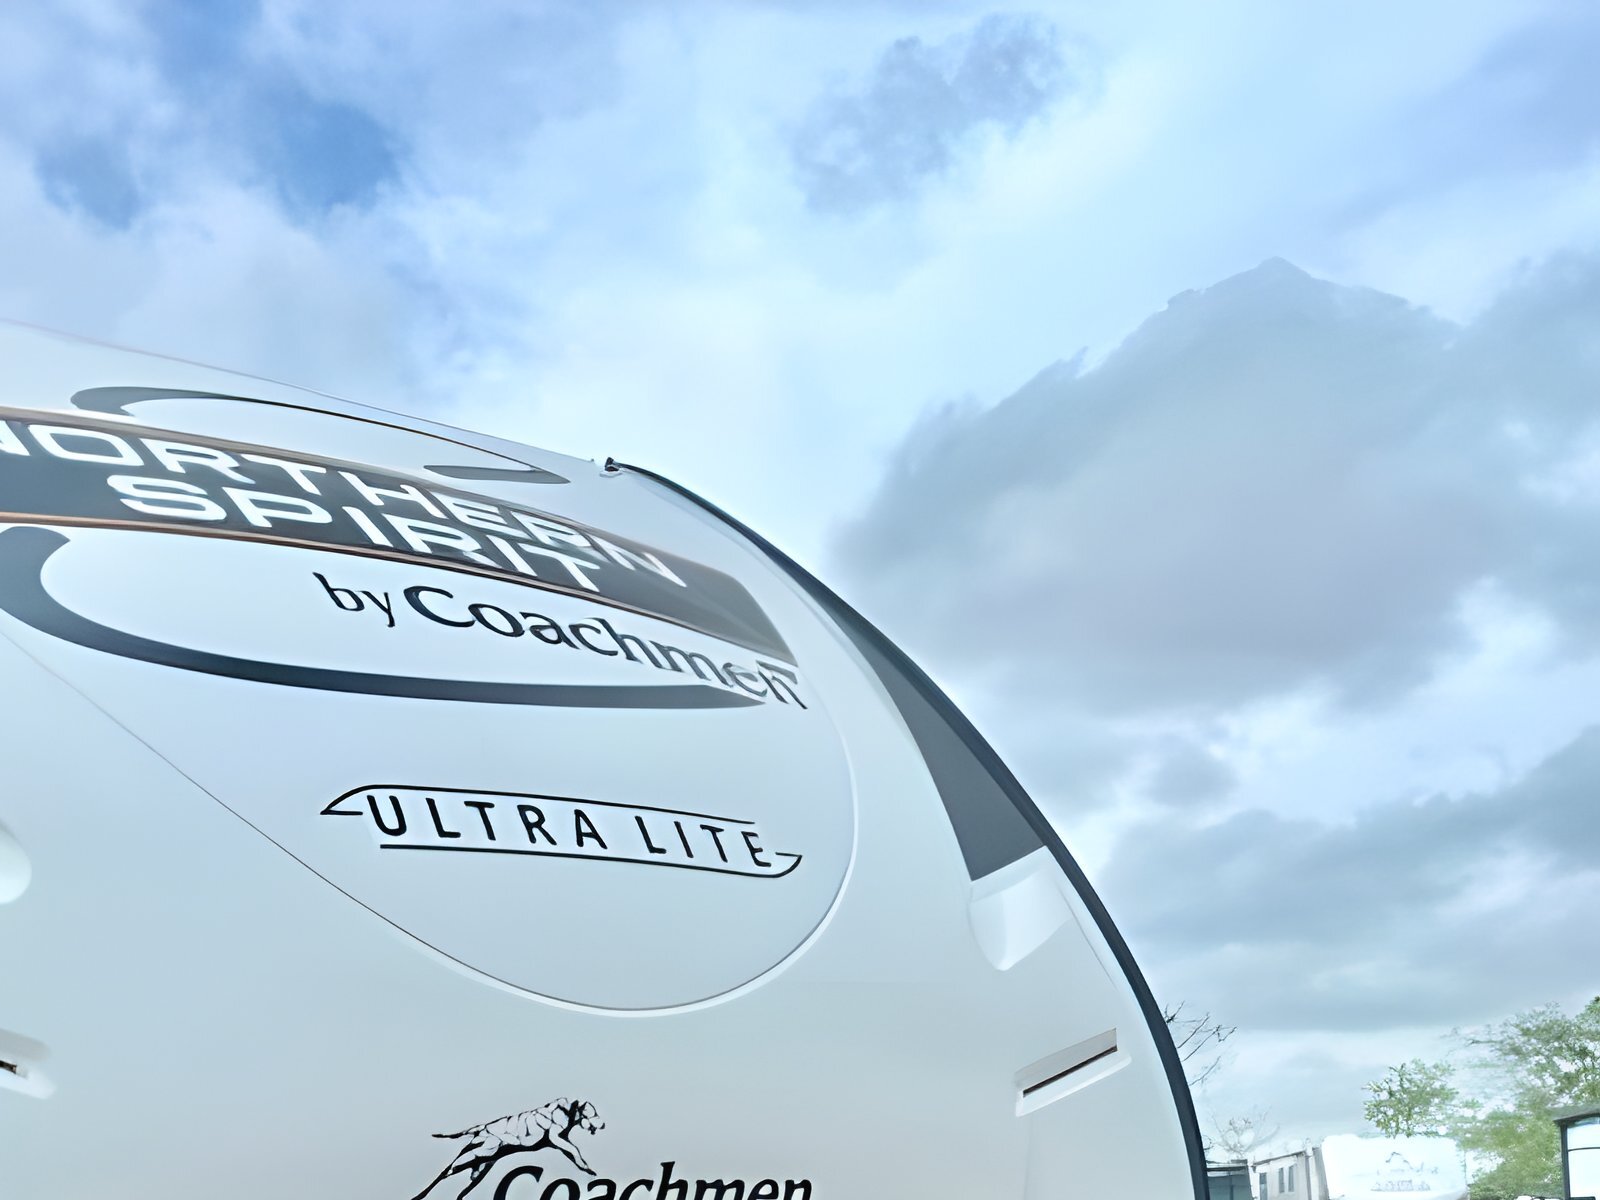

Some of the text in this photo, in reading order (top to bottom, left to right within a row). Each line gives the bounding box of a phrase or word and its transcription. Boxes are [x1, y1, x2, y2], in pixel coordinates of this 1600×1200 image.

[106, 474, 600, 593] SPIRIT
[312, 572, 808, 710] by Coachmen
[366, 795, 772, 868] ULTRA LITE
